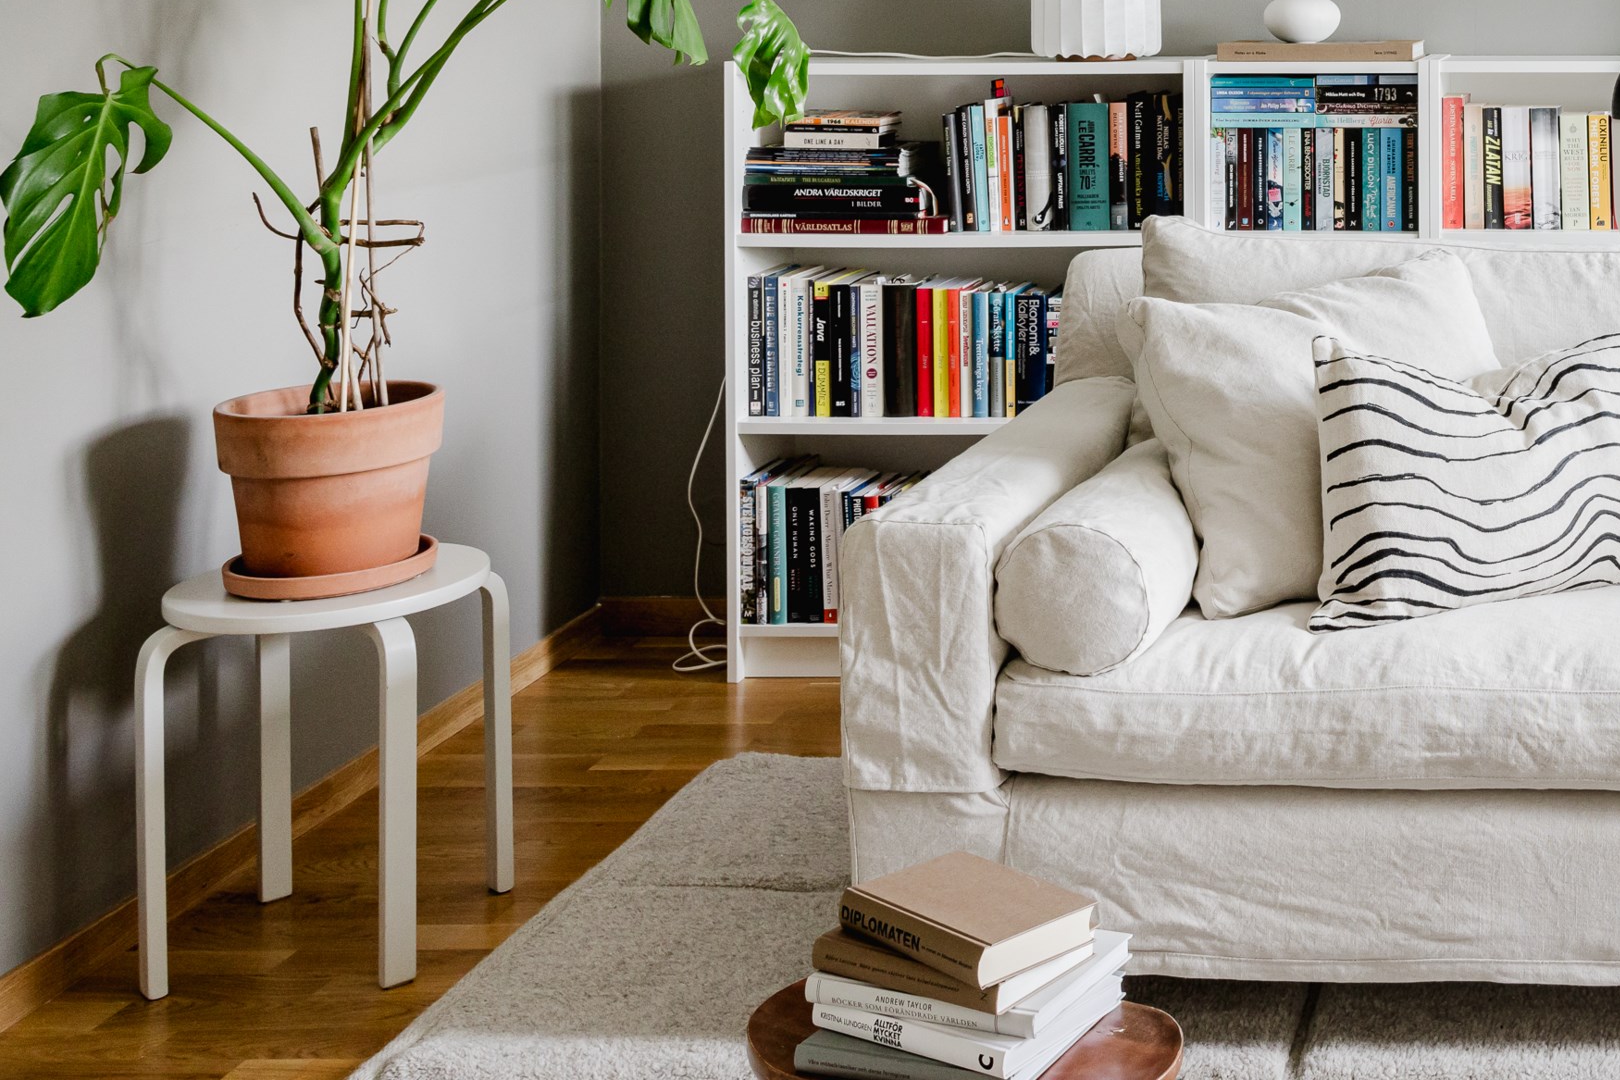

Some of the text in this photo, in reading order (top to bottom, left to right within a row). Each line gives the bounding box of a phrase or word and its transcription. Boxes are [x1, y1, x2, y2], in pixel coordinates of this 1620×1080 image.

[1134, 101, 1144, 117] Neil
[1374, 88, 1397, 101] 1793
[1135, 119, 1143, 149] Gaiman
[1337, 116, 1393, 126] Hellberg Gloria
[1591, 120, 1599, 137] THE
[804, 138, 813, 146] ONE
[815, 138, 827, 146] LINE
[829, 138, 833, 146] A
[1078, 121, 1099, 168] LE CARRÉ
[1288, 136, 1295, 146] LE
[1599, 118, 1608, 162] CIXIN LIU
[1134, 152, 1143, 196] Amerikanska
[1366, 133, 1375, 188] LUCY DILLON
[1406, 151, 1415, 182] PRATCHETT
[1485, 136, 1501, 185] ZLATAN
[794, 186, 883, 197] ANDRA VÄRLDSKRIGET
[1080, 176, 1091, 190] 70
[1386, 176, 1397, 217] AMERICANAH
[1592, 170, 1600, 209] FOREST
[857, 200, 882, 208] BILDER
[795, 221, 853, 231] VÄRLDSATLAS
[796, 295, 805, 376] Konkurrensstrategi
[816, 317, 827, 342] Java
[866, 304, 877, 364] VALUATION
[1016, 300, 1028, 342] Kalkyler
[1029, 300, 1040, 356] Ekonomi&
[750, 320, 763, 365] business
[766, 296, 776, 393] BLUE OCEAN STRATEGY
[921, 354, 929, 369] Java
[748, 367, 763, 390] plan
[817, 367, 828, 406] DUMMIES
[974, 380, 984, 400] kriget
[772, 493, 781, 550] GATA GATA
[791, 506, 799, 527] ONLY
[741, 496, 754, 591] SVERIGESOMMAR
[823, 493, 834, 605] John Doerr Measure What Matters
[841, 905, 921, 951] DIPLOMATEN
[831, 996, 978, 1028] BÖCKER SOM FÖRÄNDRADE VÄRLDEN
[875, 995, 933, 1012] ANDREW TAYLOR
[820, 1011, 873, 1033] KRISTINA LUNDGREN
[873, 1018, 903, 1034] ALLTFÖR
[873, 1028, 901, 1041] MYCKET
[873, 1035, 903, 1048] KVINNA
